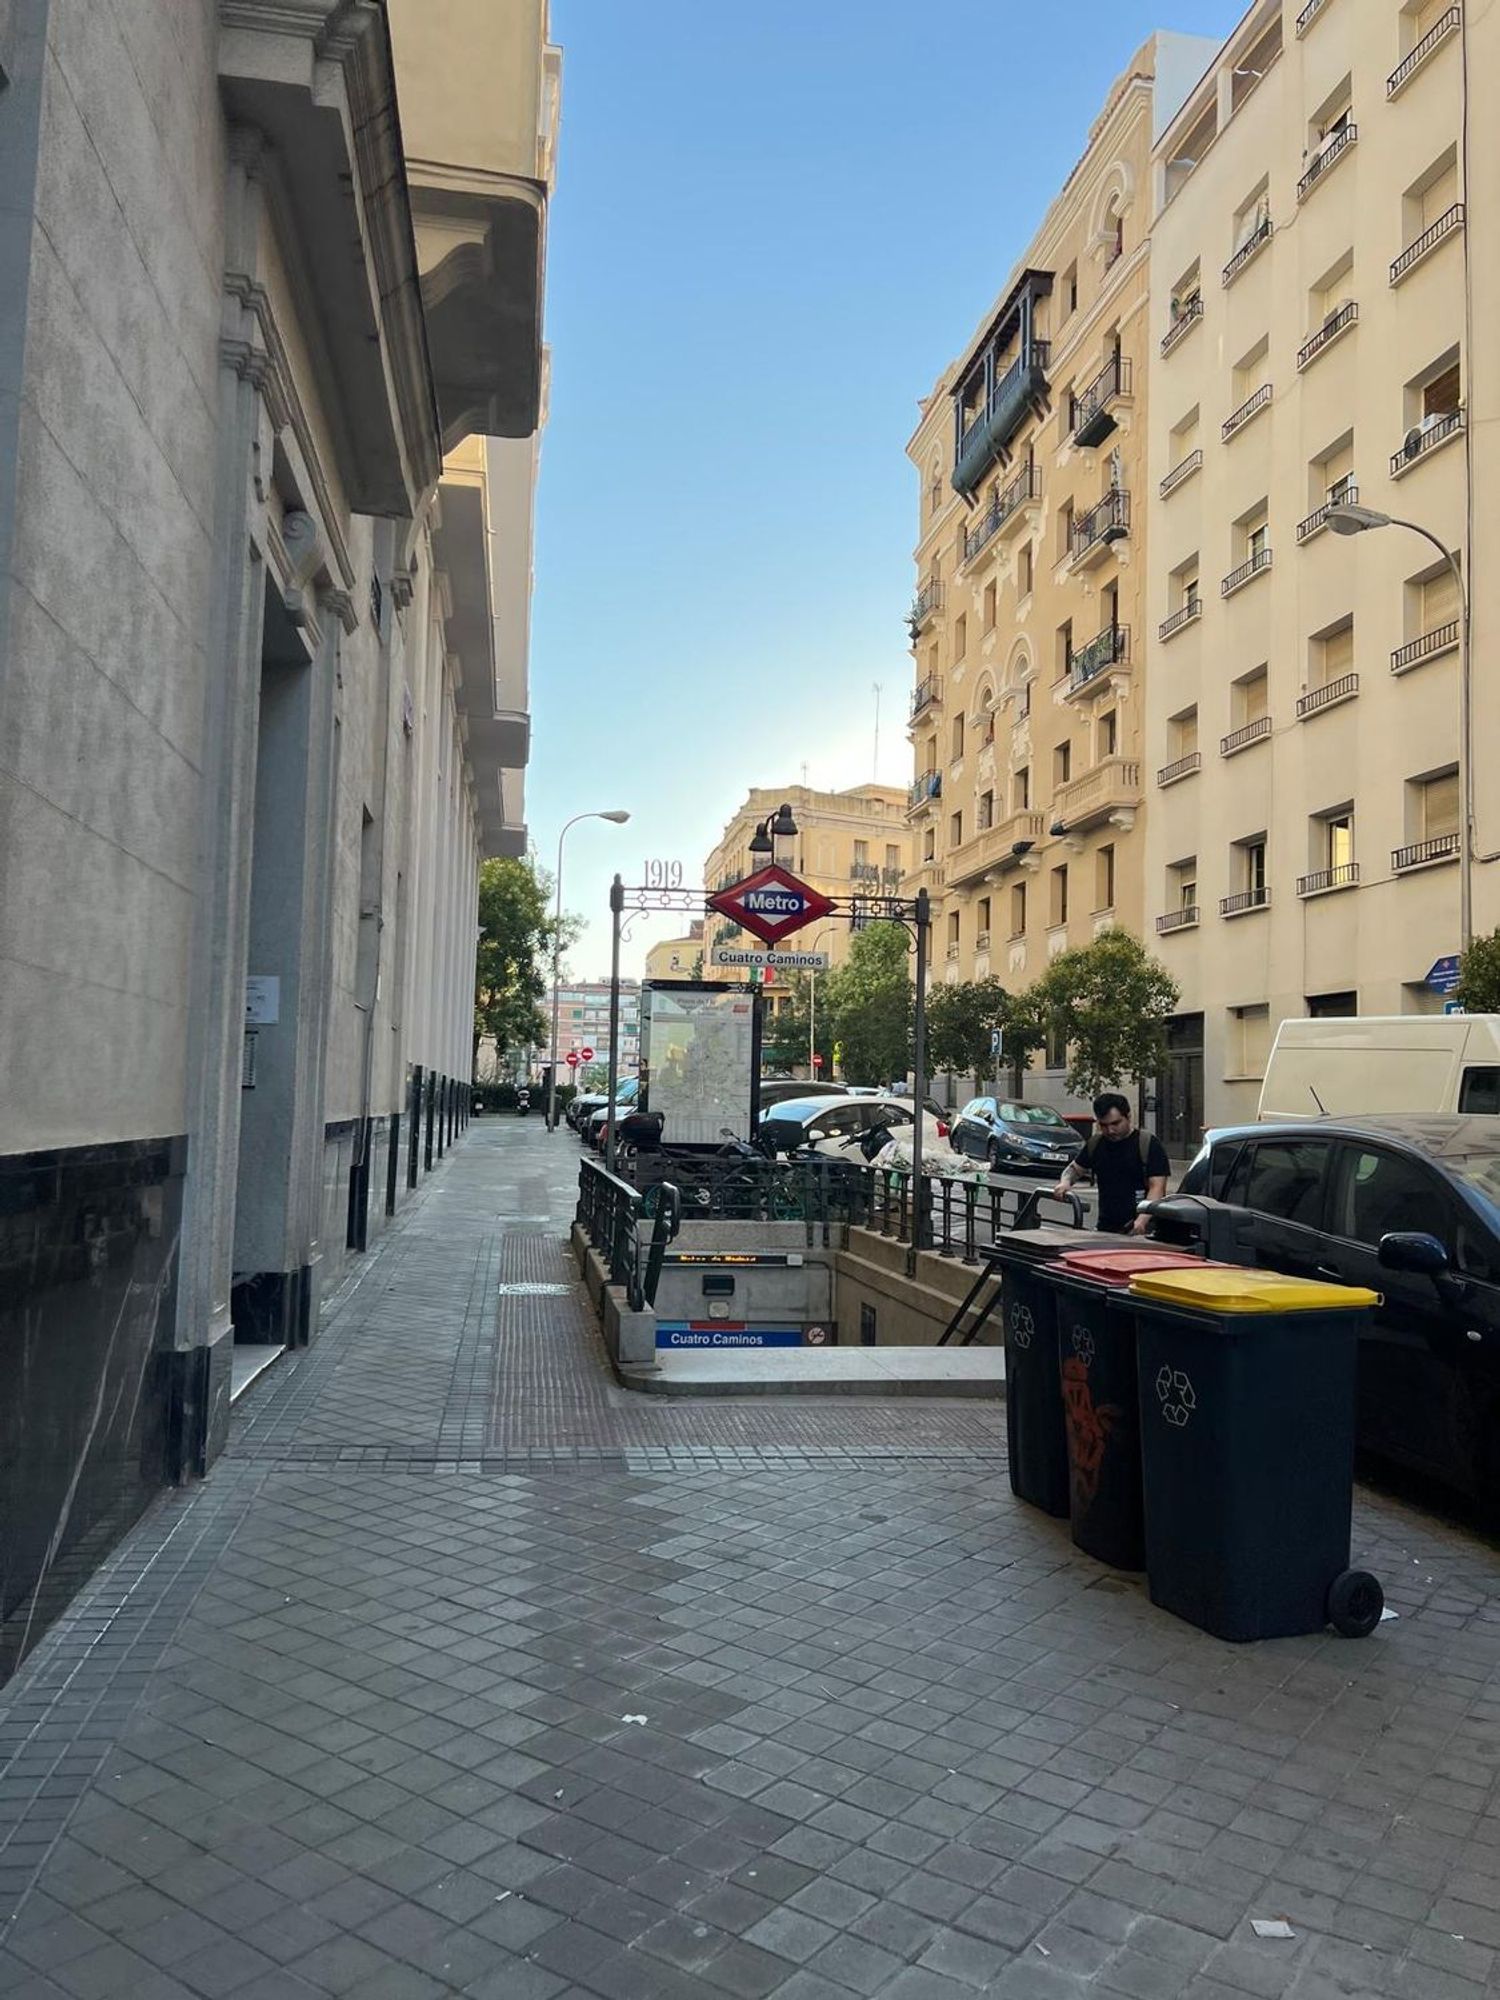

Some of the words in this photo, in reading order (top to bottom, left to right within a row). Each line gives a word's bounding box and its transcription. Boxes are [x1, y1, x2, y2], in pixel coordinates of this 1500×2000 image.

[644, 859, 683, 889] 1919
[749, 893, 800, 911] Metro
[718, 951, 763, 963] Cuatro
[766, 953, 823, 966] Caminos
[991, 1033, 999, 1052] P
[670, 1333, 710, 1344] Cuatro
[713, 1333, 763, 1345] Caminos
